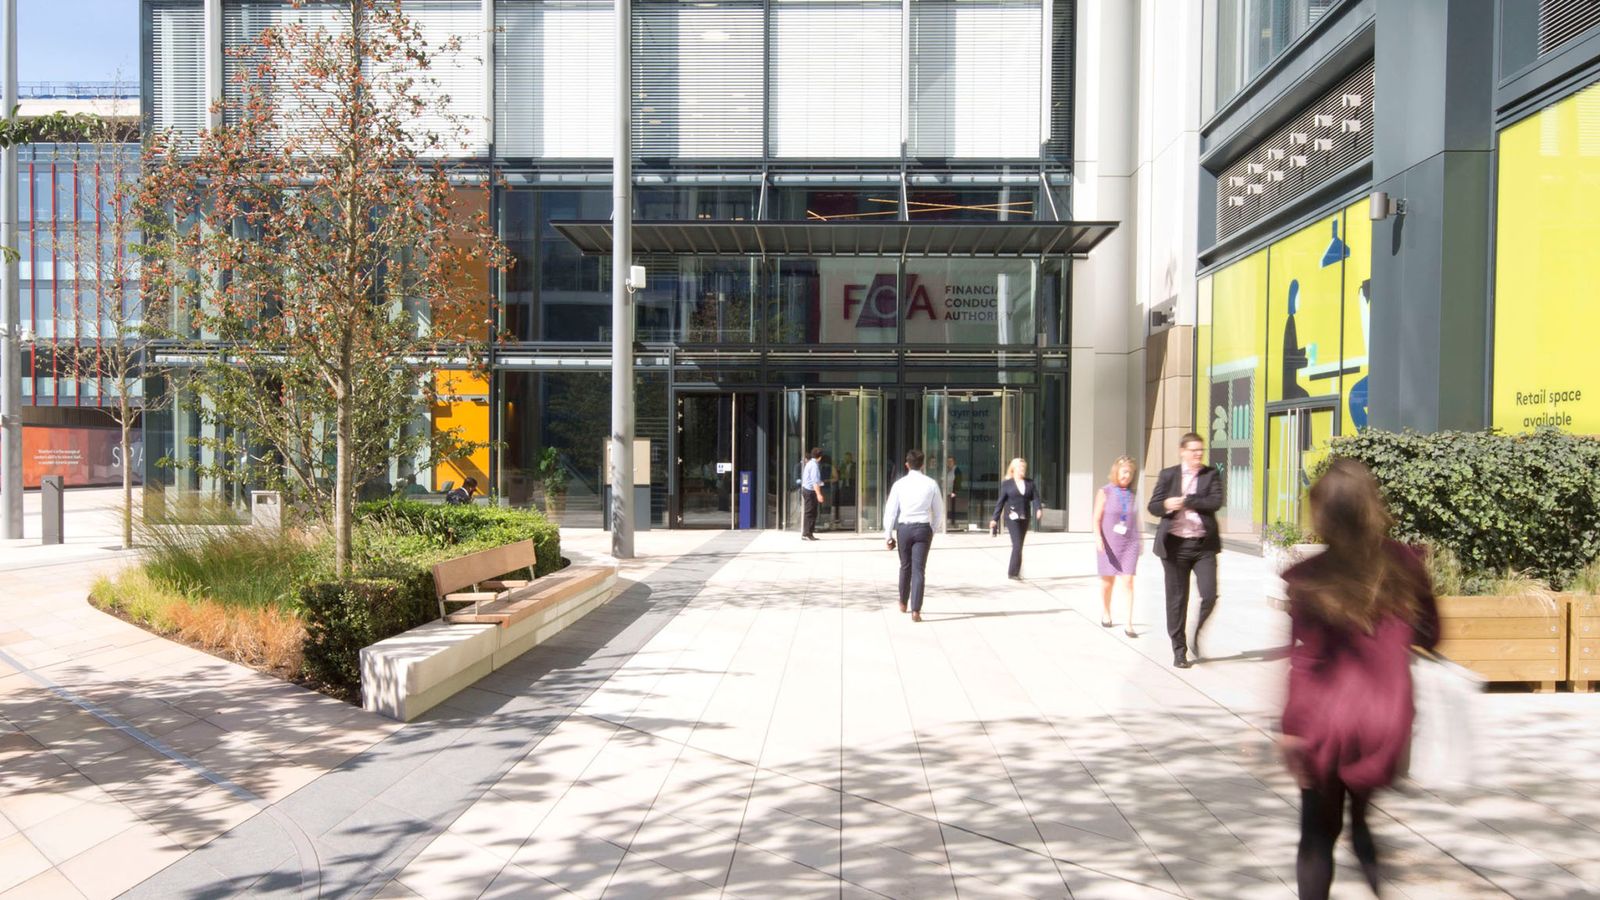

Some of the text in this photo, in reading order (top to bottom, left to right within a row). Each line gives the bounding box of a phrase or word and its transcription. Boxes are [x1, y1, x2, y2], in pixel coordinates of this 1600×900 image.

[945, 285, 1009, 295] FINANCIA
[843, 284, 938, 320] FCA
[945, 298, 999, 308] CONDUC
[945, 311, 1013, 321] AUTHORIY
[1516, 389, 1581, 407] Retail space
[1523, 412, 1572, 428] available
